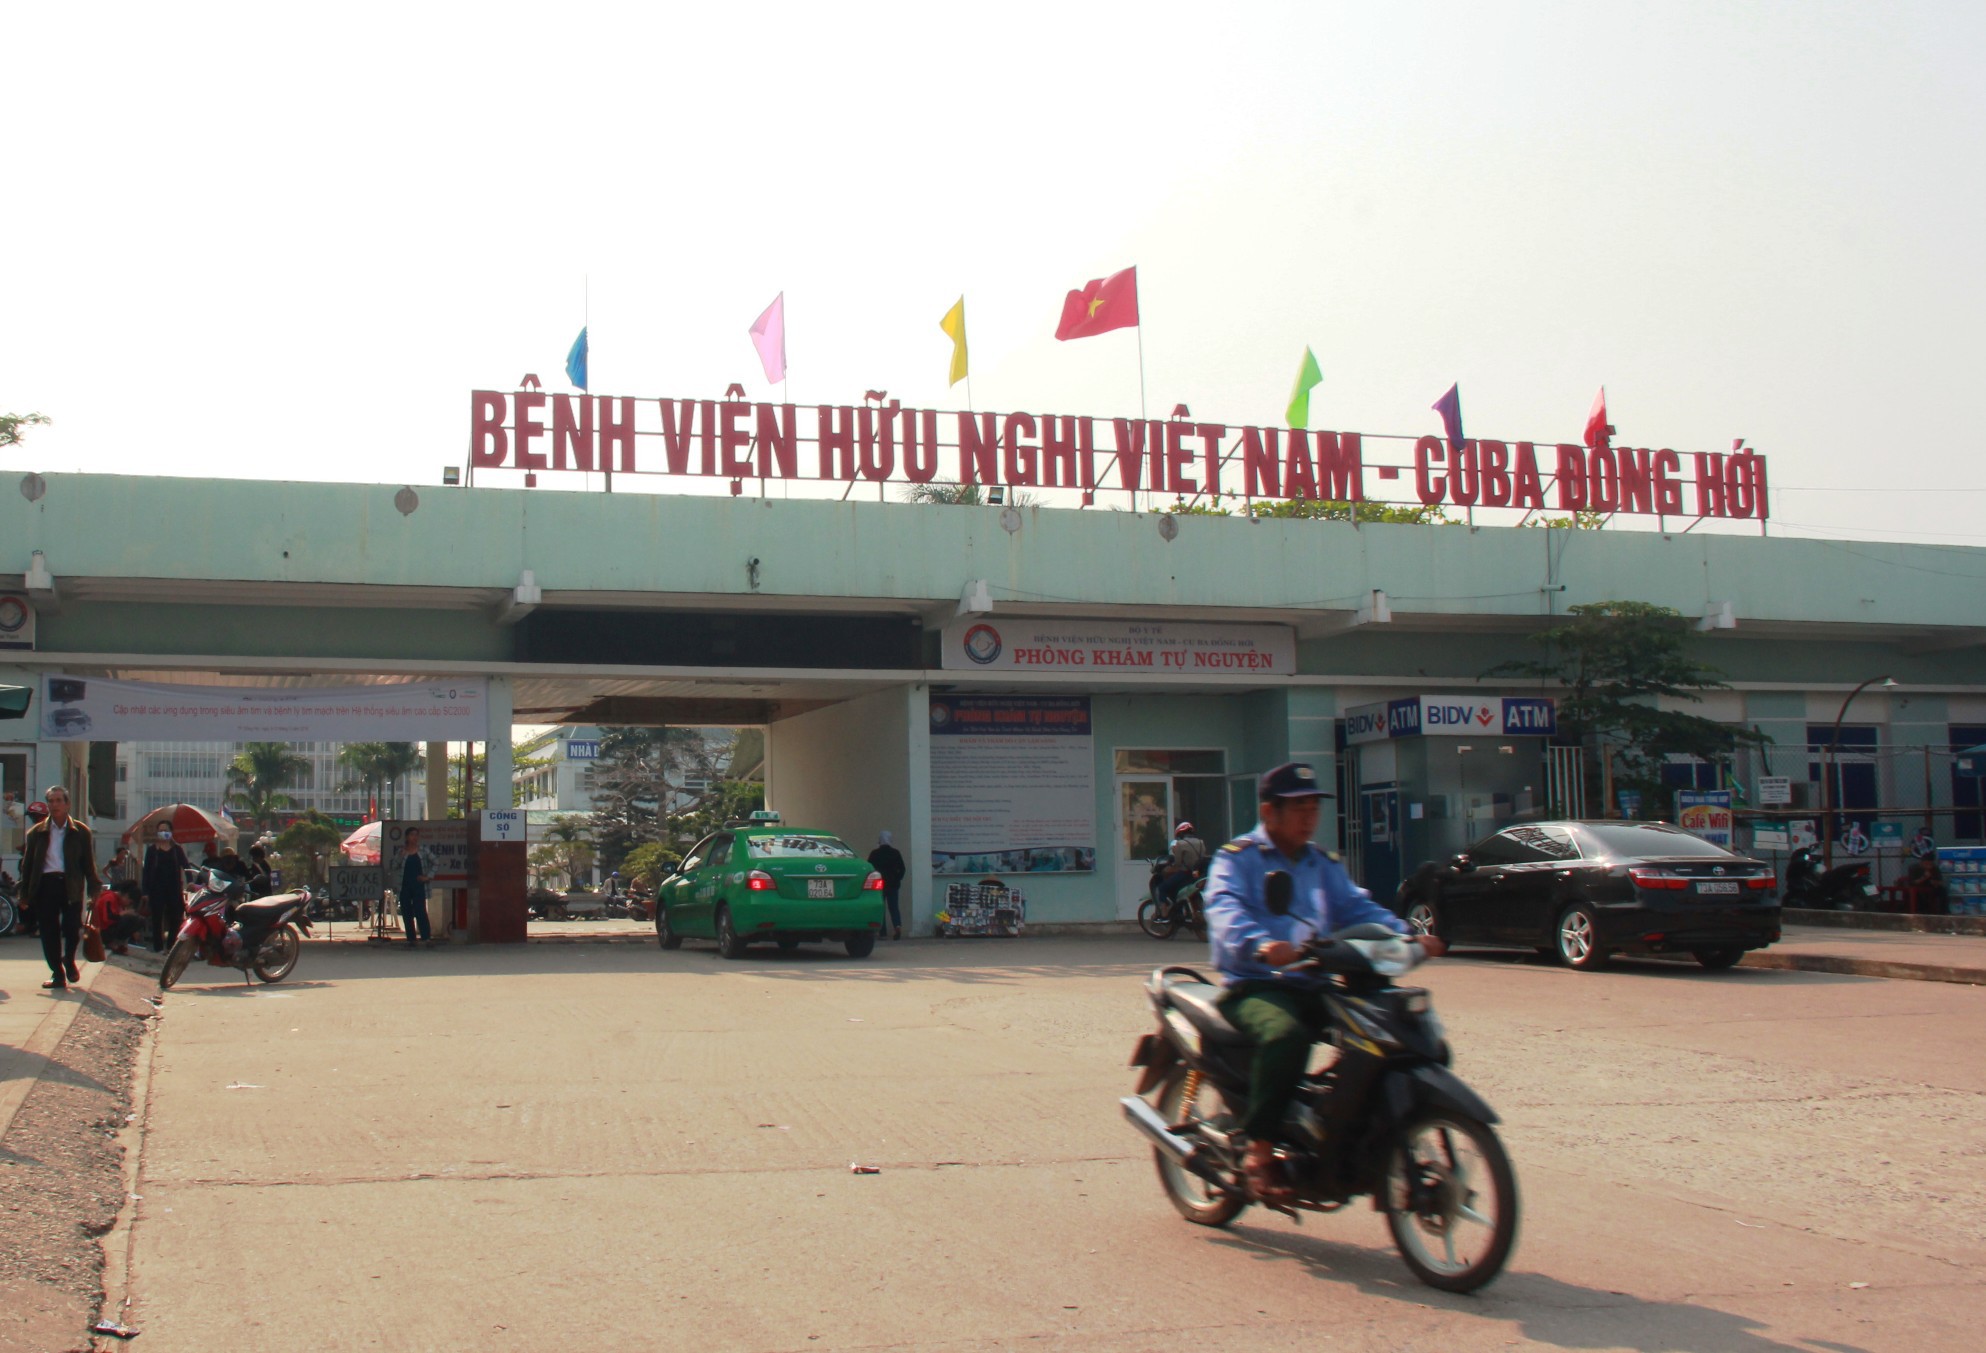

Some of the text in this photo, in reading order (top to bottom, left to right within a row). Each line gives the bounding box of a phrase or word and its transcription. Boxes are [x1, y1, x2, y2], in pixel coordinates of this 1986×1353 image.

[471, 373, 636, 488] BỆNH
[659, 383, 798, 496] VIỆN
[819, 390, 938, 482] HỮU
[958, 411, 1094, 506] NGHỊ
[1113, 403, 1226, 500] VIỆT
[1242, 426, 1364, 502] NAM
[1379, 465, 1399, 480] -
[1555, 425, 1684, 517] ĐỒNG
[1694, 438, 1770, 520] HỚI
[1013, 644, 1273, 672] PHÒNG KHÁM TỰ NGUYỆN
[200, 706, 218, 717] trong
[250, 705, 261, 715] tim
[442, 706, 471, 717] SC2000
[1427, 705, 1550, 728] BIDV ATM
[1347, 705, 1419, 735] BIDV ATM
[570, 743, 592, 757] NHÀ
[489, 808, 518, 820] CỔNG
[1682, 812, 1729, 829] Café Wifi
[496, 820, 510, 831] SỐ
[814, 879, 828, 889] 73A
